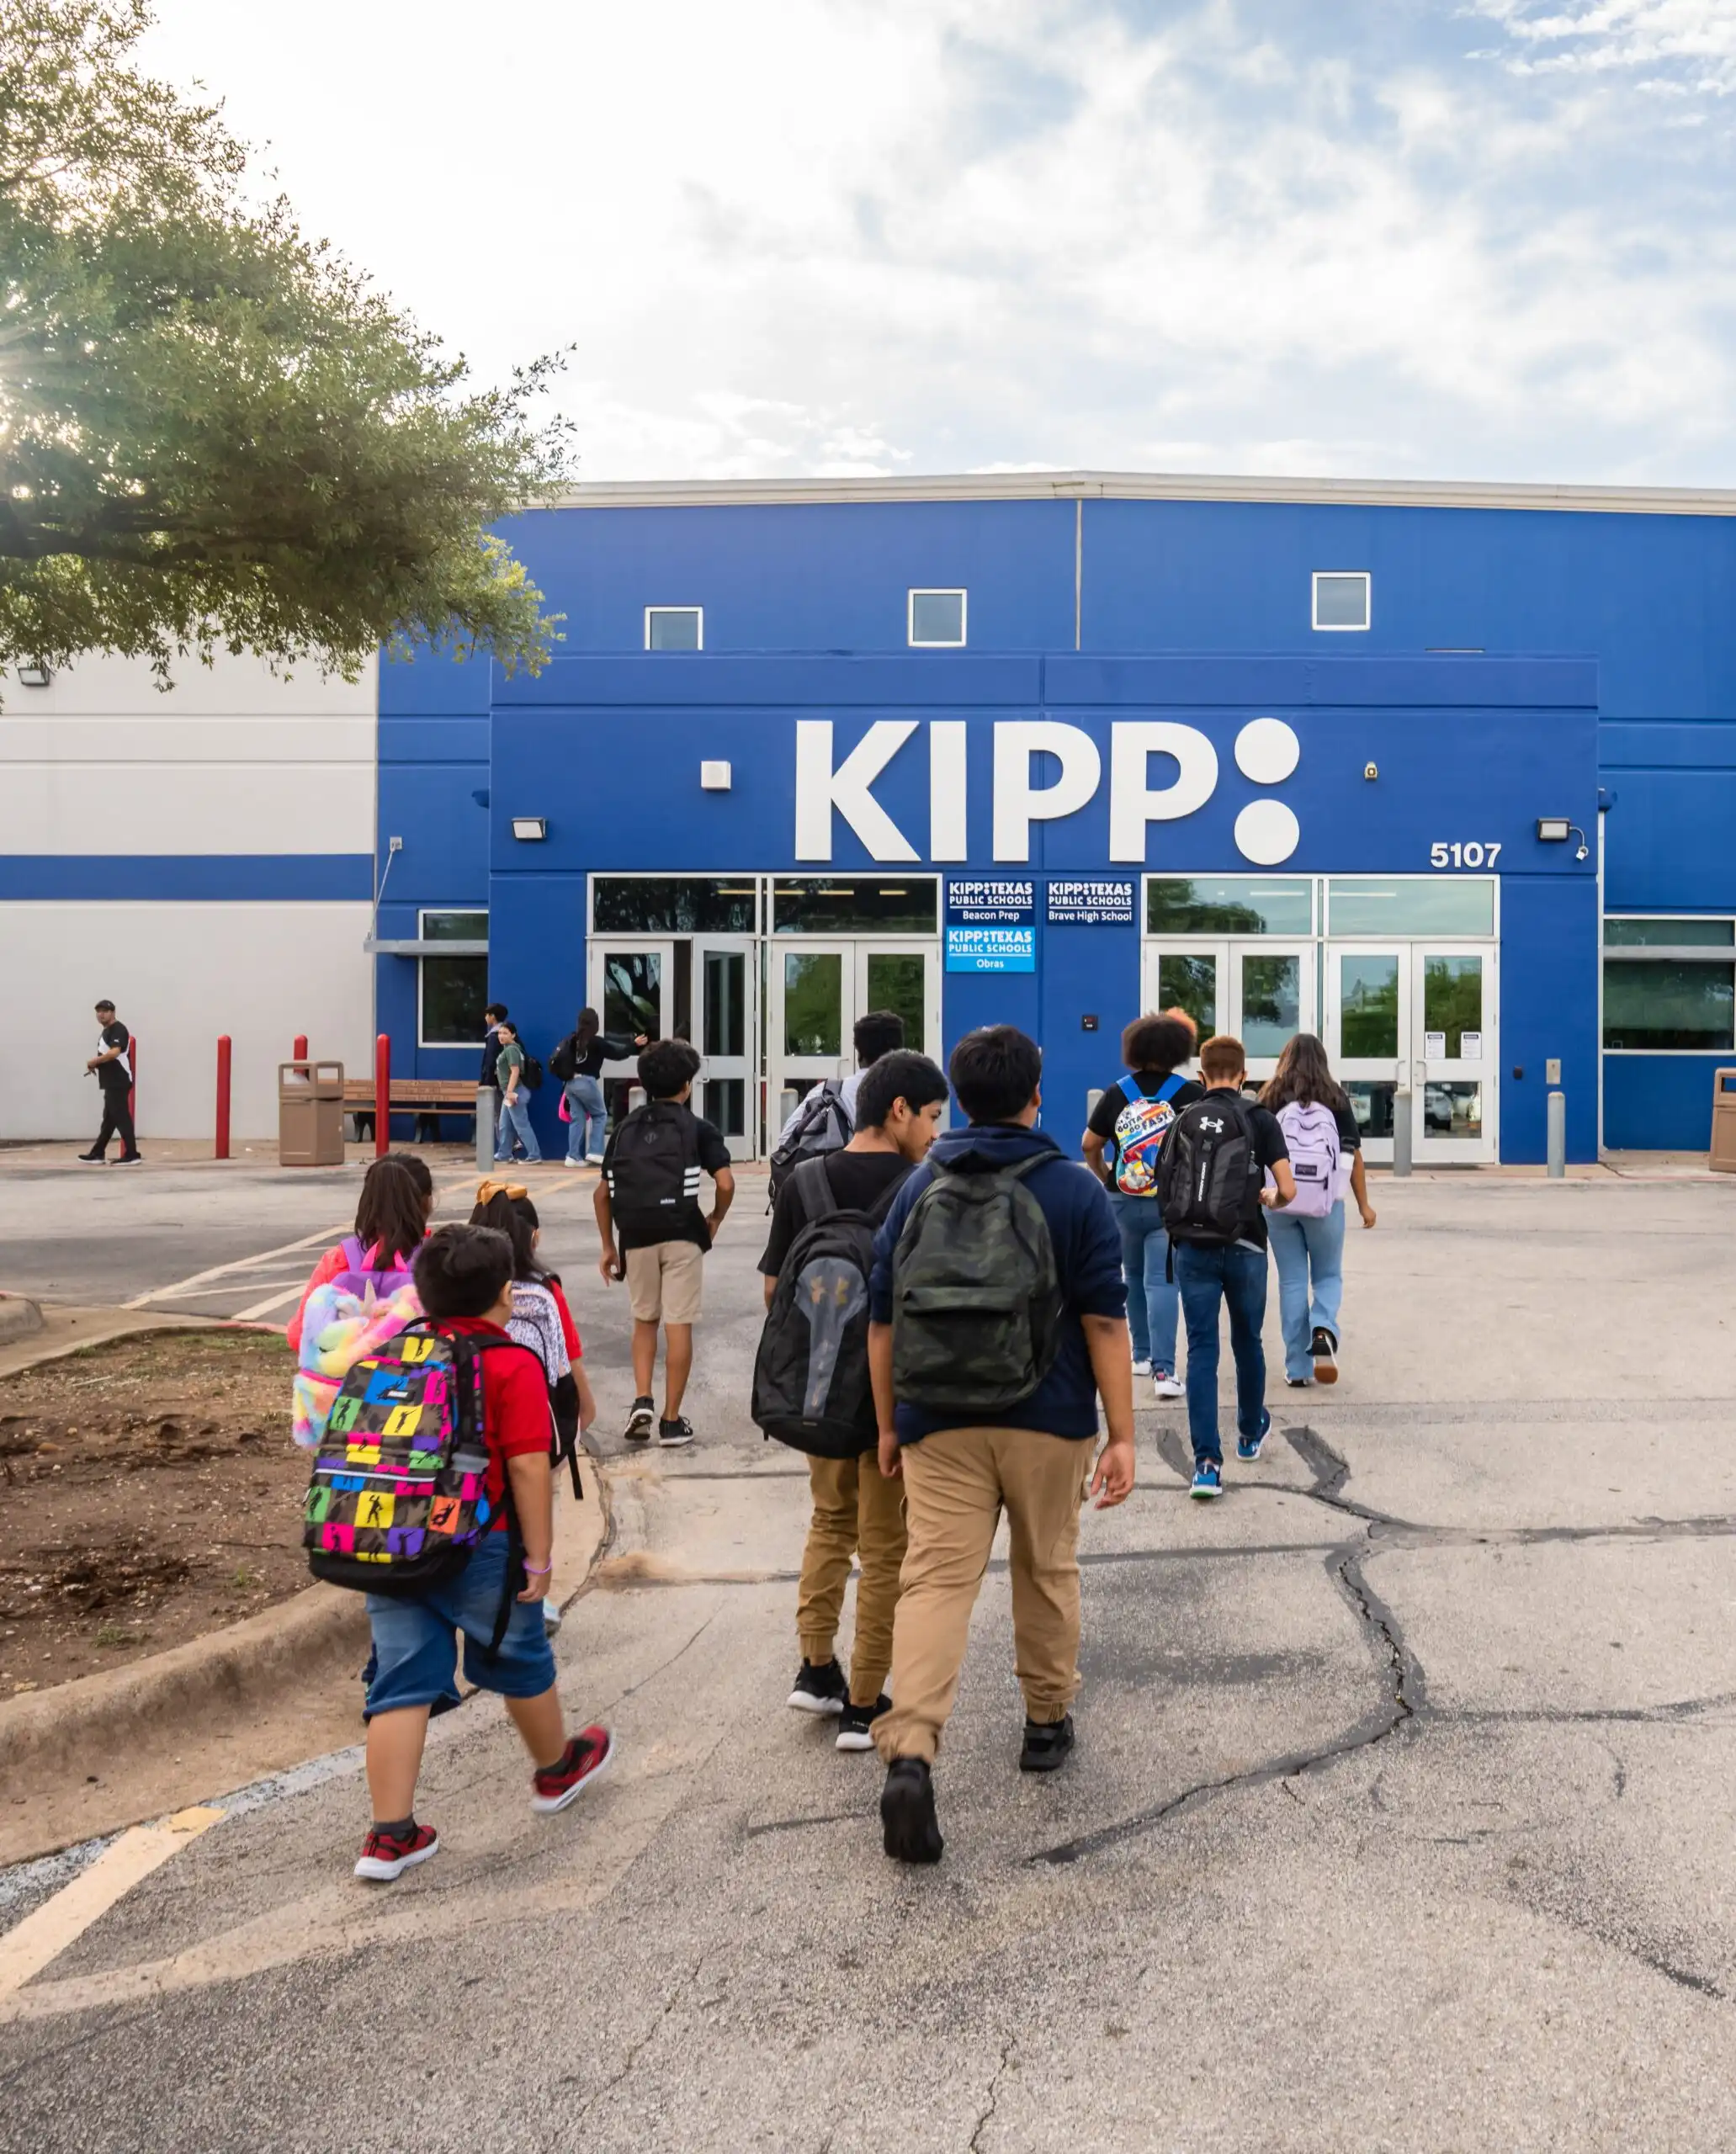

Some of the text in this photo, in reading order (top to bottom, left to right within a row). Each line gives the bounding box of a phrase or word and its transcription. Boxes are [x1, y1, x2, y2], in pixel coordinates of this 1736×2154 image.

[794, 717, 1301, 866] KIPP:
[1430, 841, 1503, 868] 5107
[949, 882, 1033, 895] KIPP:TEXAS
[1049, 883, 1133, 896] KIPP:TEXAS
[949, 895, 1033, 905] PUBLIC SCHOOLS
[1049, 896, 1133, 906] PUBLIC SCHOOLS
[962, 910, 1020, 922] Beacon Prep
[1049, 910, 1133, 923] Brave High School
[948, 930, 1033, 943] KIPP:TEXAS
[948, 944, 1033, 953] PUBLIC SCHOOLS
[976, 958, 1005, 968] Obras
[1118, 1115, 1142, 1133] GOTTA
[1142, 1111, 1168, 1130] FAST
